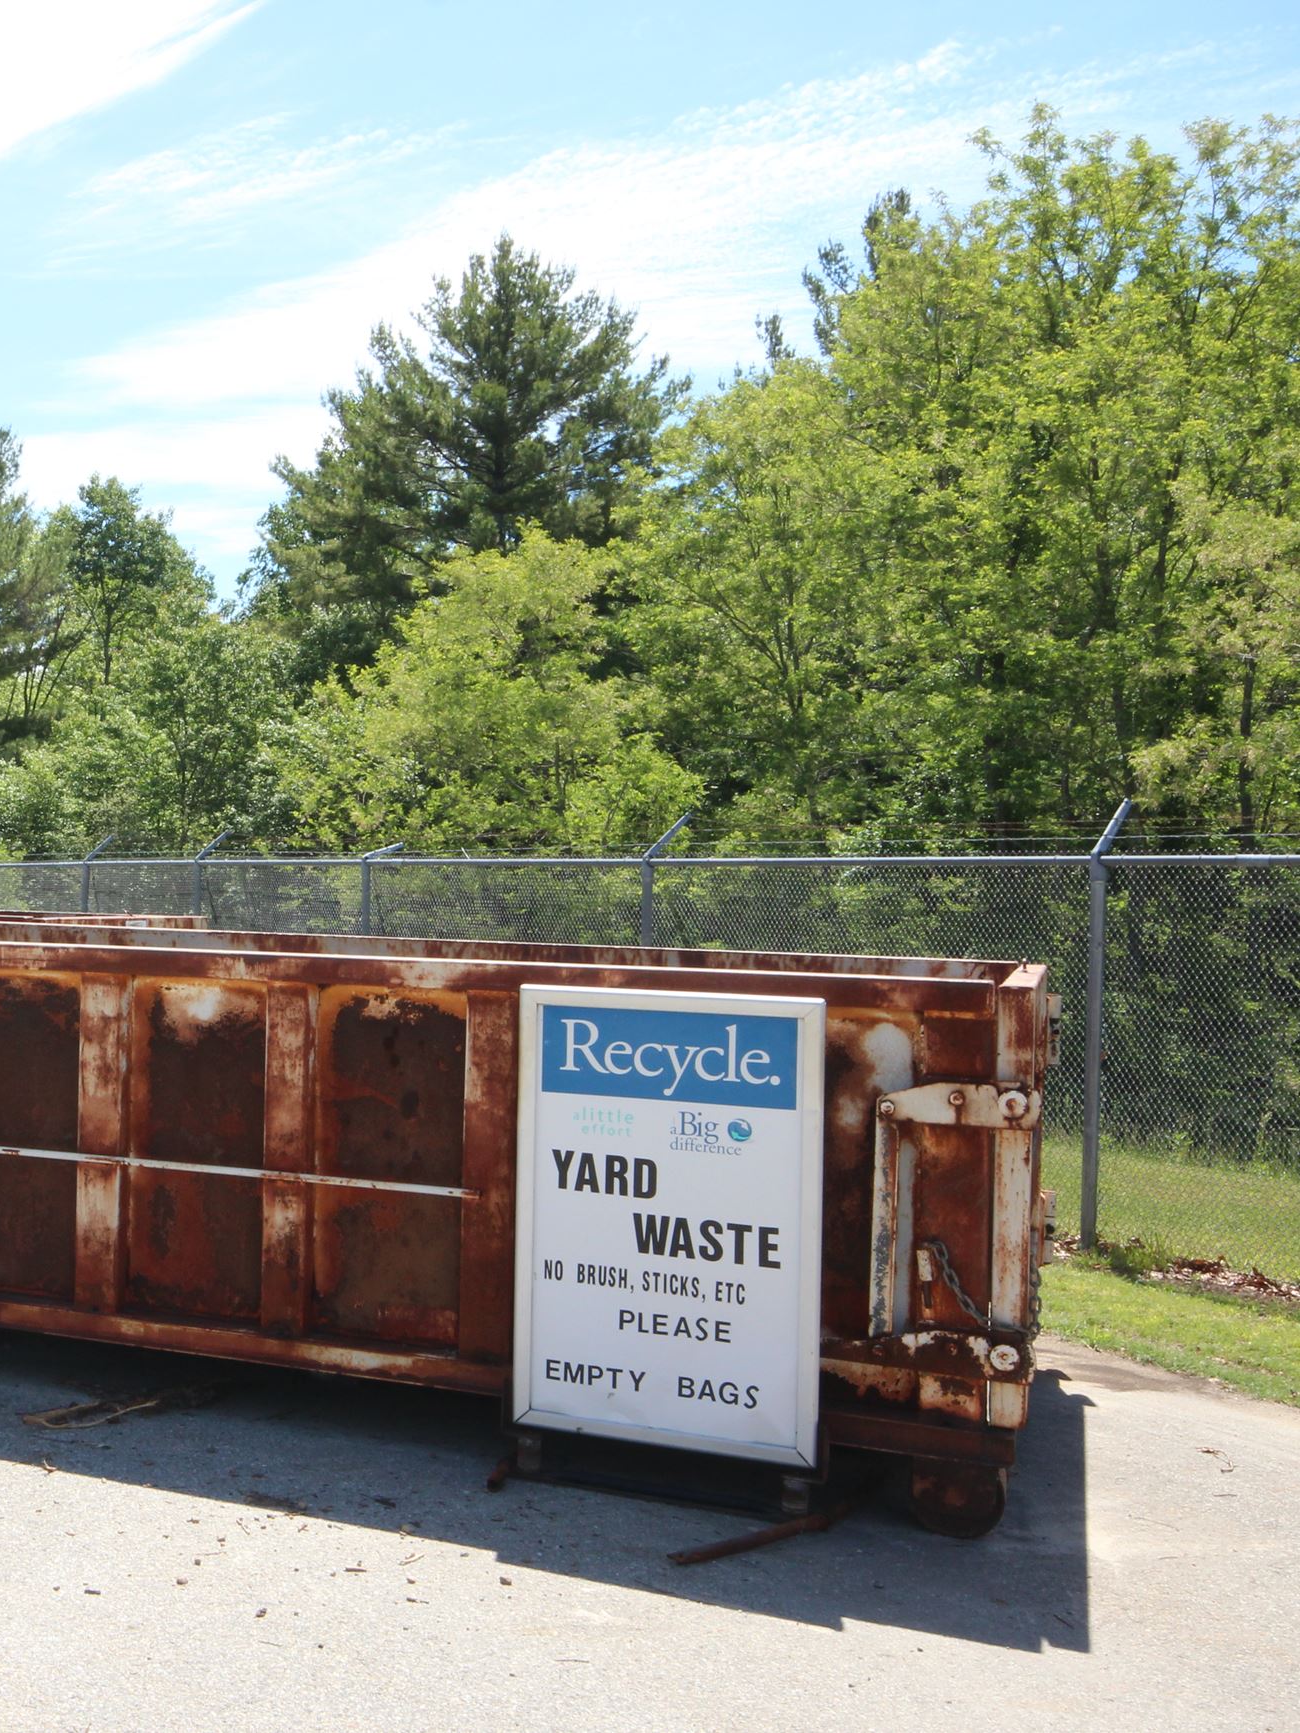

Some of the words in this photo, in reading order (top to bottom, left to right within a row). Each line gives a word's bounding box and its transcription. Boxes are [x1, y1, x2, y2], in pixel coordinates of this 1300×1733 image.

[559, 1018, 781, 1096] Recycle.
[581, 1124, 632, 1137] effort
[669, 1125, 677, 1135] a
[678, 1111, 719, 1144] Big
[669, 1137, 742, 1156] difference
[552, 1149, 658, 1199] YARD
[633, 1213, 781, 1269] WASTE
[544, 1259, 564, 1281] NO
[577, 1263, 635, 1294] BRUSH,
[642, 1271, 706, 1303] STICKS,
[715, 1281, 746, 1305] ETC
[619, 1309, 732, 1343] PLEASE
[545, 1359, 646, 1392] EMPTY
[677, 1376, 760, 1409] BAGS
